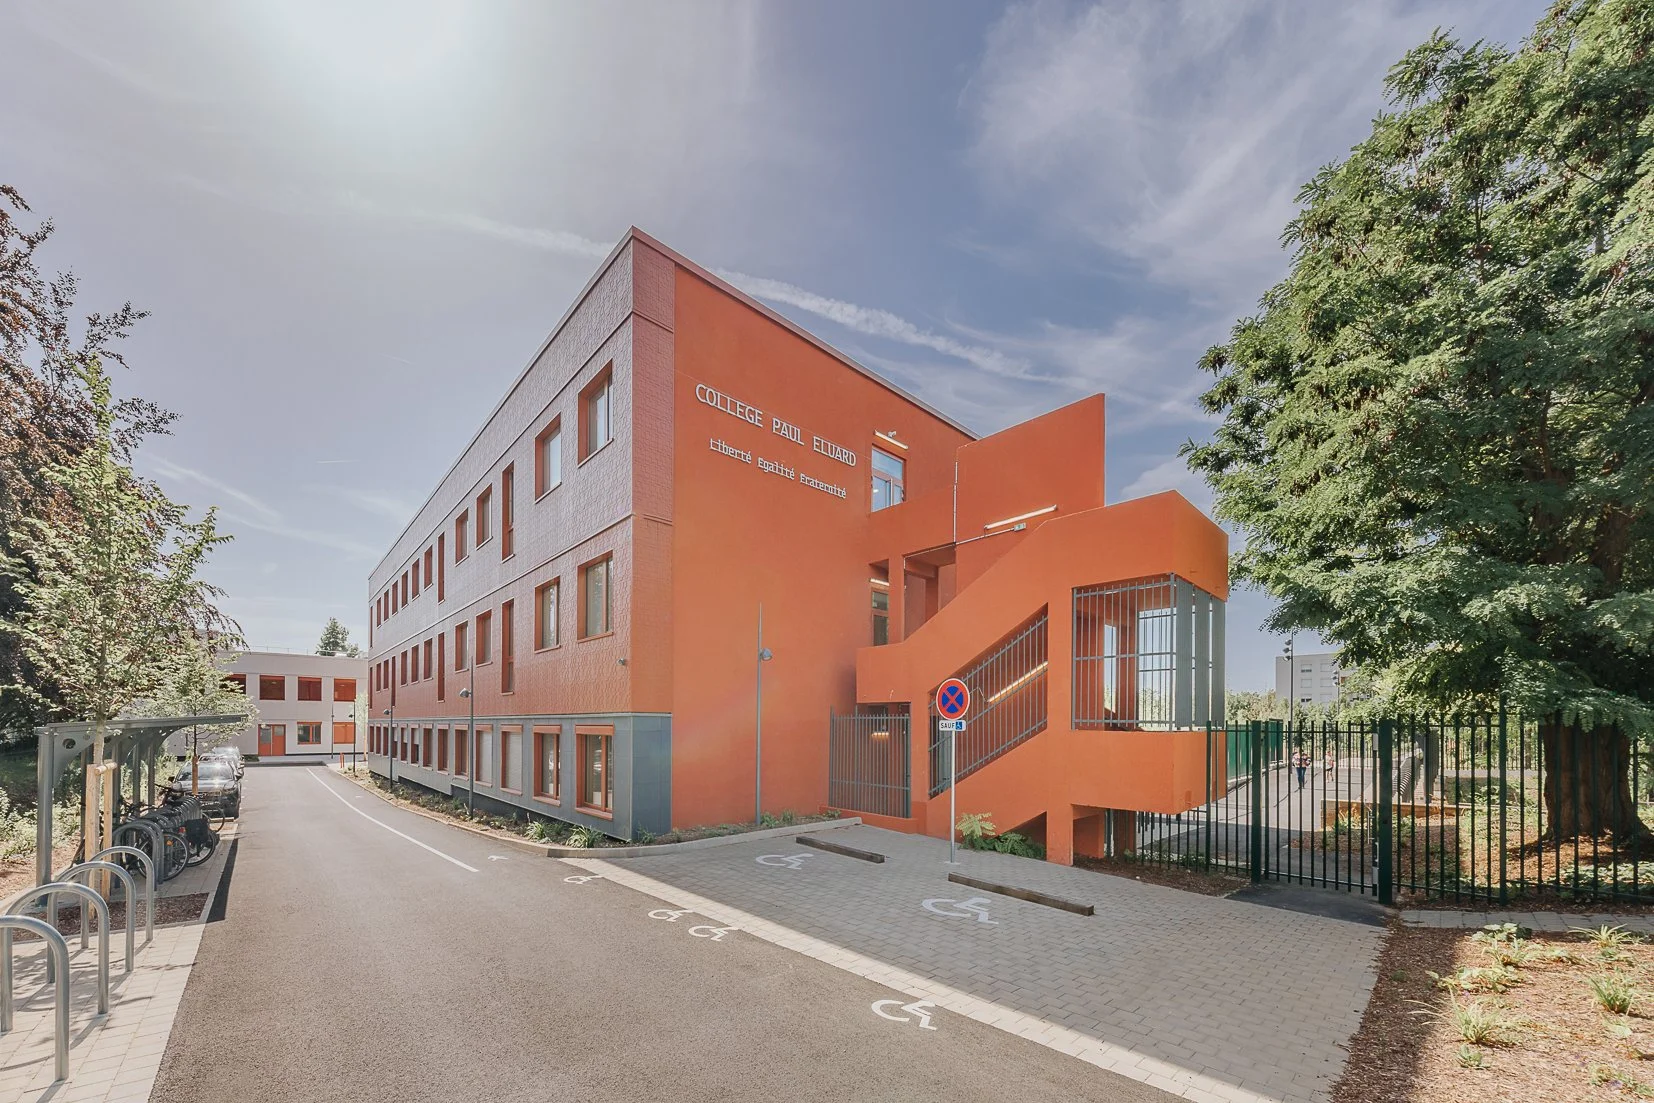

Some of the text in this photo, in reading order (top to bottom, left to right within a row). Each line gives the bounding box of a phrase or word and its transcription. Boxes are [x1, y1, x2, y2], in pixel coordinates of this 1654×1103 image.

[695, 383, 857, 467] COLLEGE PAUL ELUARD
[709, 438, 846, 499] Liberté Egalité Fraternité
